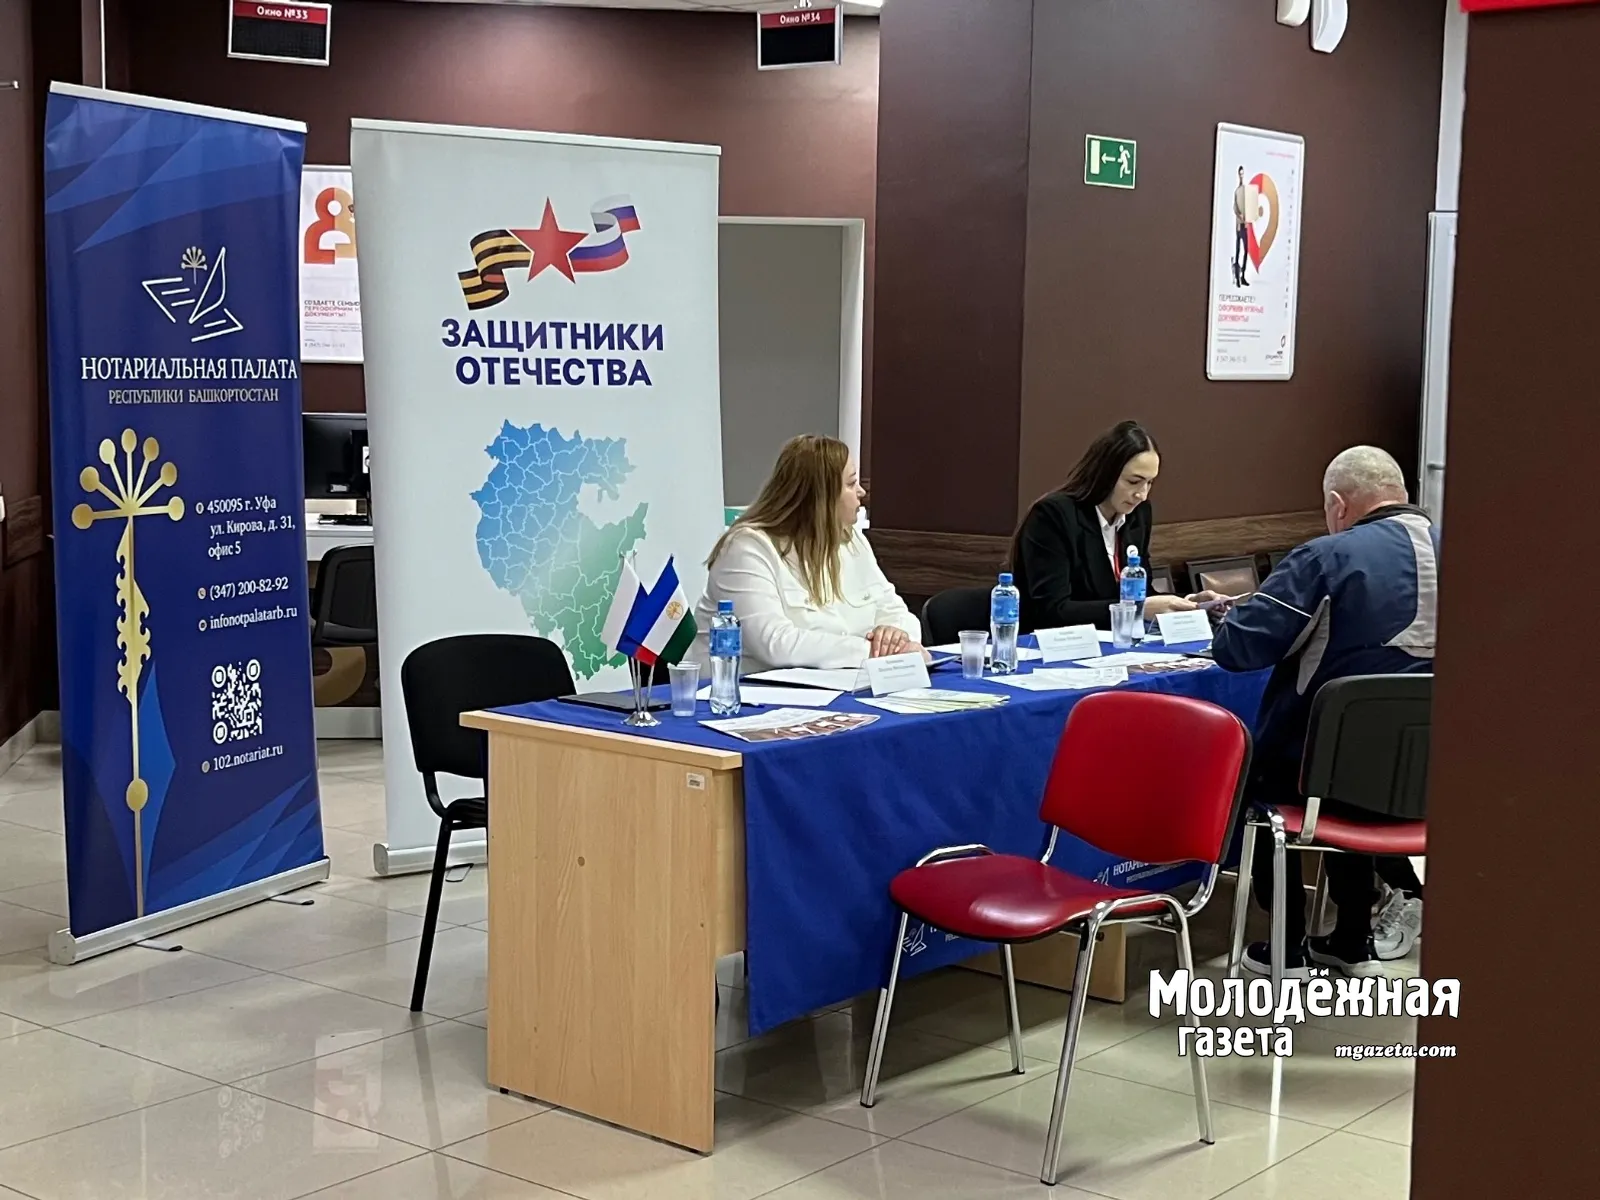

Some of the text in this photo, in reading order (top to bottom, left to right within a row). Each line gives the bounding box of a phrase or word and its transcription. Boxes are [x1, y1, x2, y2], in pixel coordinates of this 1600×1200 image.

[257, 6, 308, 20] Окно №33
[780, 12, 820, 24] Окно №34
[441, 318, 664, 352] ЗАЩИТНИКИ
[81, 357, 298, 380] НОТАРИАЛЬНАЯ ПАЛАТА
[455, 356, 652, 386] ОТЕЧЕСТВА
[108, 388, 279, 405] РЕСПУБЛИКИ БАШКОРТОСТАН
[207, 495, 277, 514] 450095 г. Уфа
[210, 515, 296, 539] ул. Кирова, д. 31,
[208, 541, 242, 560] офис 5
[209, 576, 289, 601] (347) 200-82-92
[210, 605, 298, 629] infonotpalatarb.ru
[213, 745, 284, 771] 102.notariat.ru
